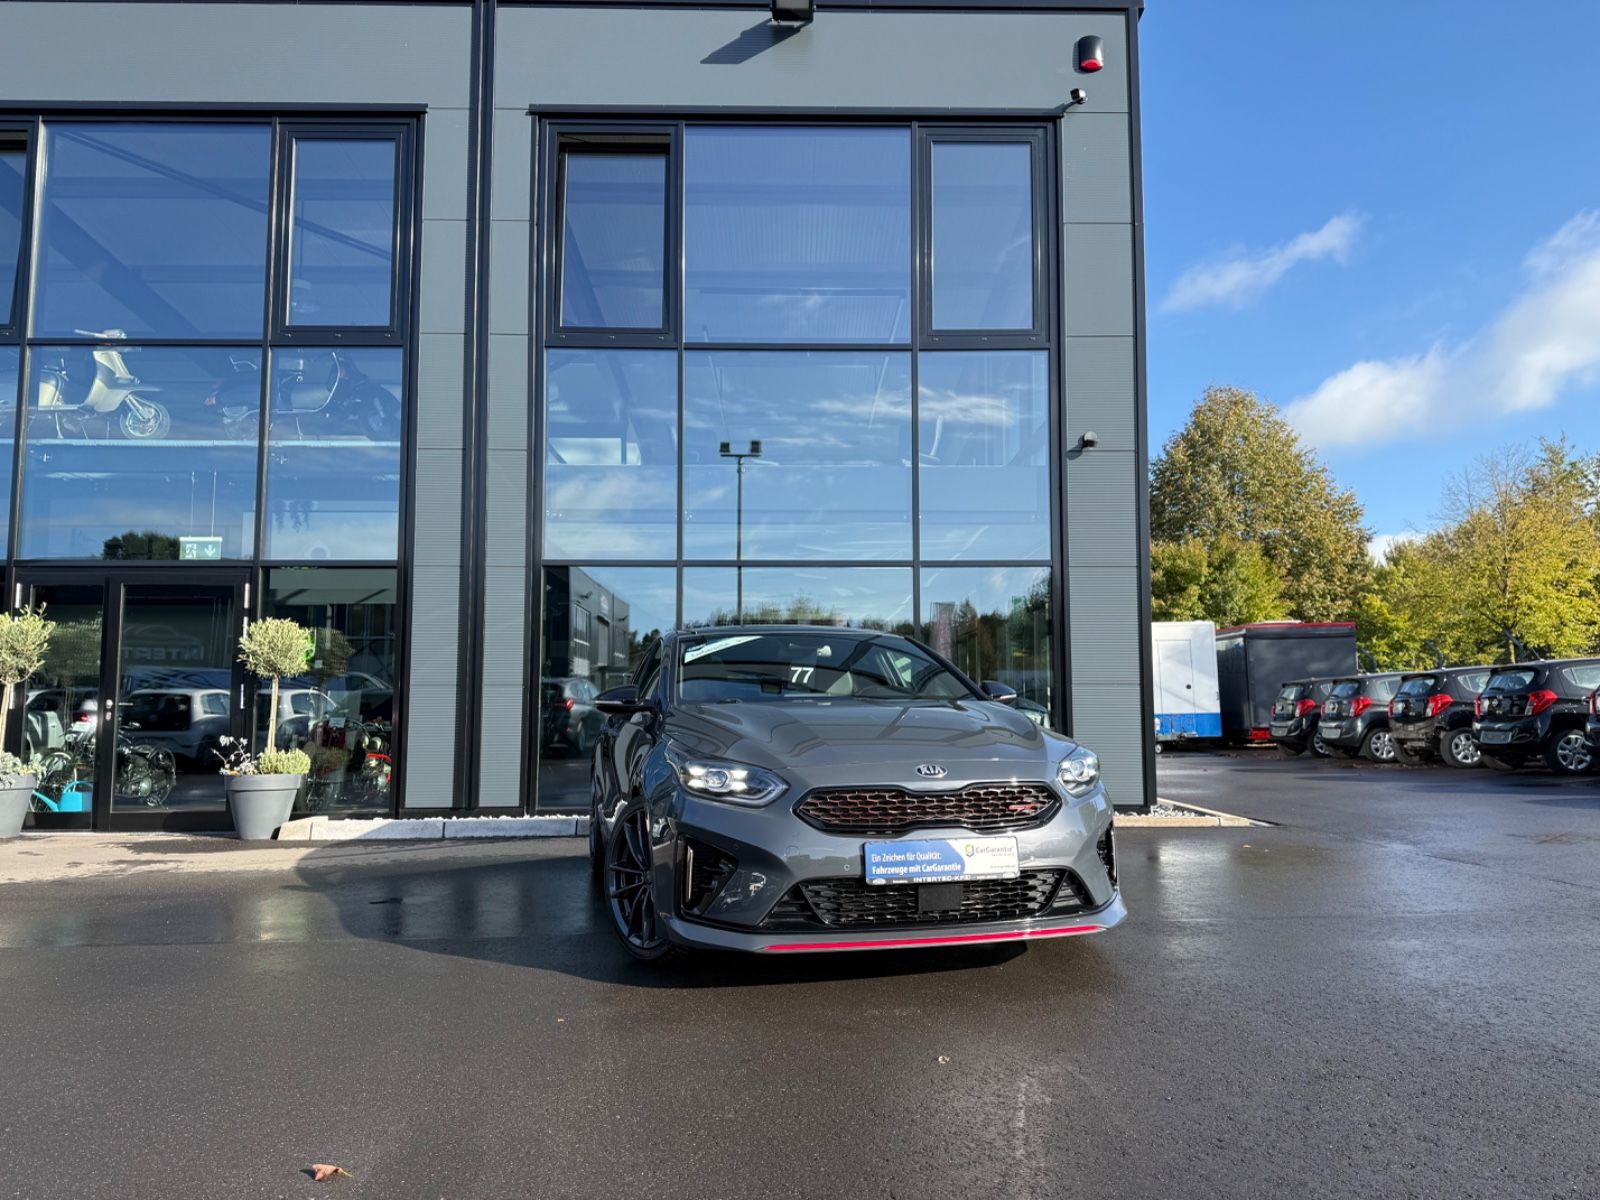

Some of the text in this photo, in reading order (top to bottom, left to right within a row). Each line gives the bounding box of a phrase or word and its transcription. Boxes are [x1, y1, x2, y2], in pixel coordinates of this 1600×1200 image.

[790, 666, 815, 684] 77
[919, 764, 944, 775] KIA
[871, 854, 881, 863] Ein
[882, 852, 905, 862] Zeichen
[906, 851, 916, 861] für
[872, 862, 961, 875] Fahrzeuge mit CarGarantie
